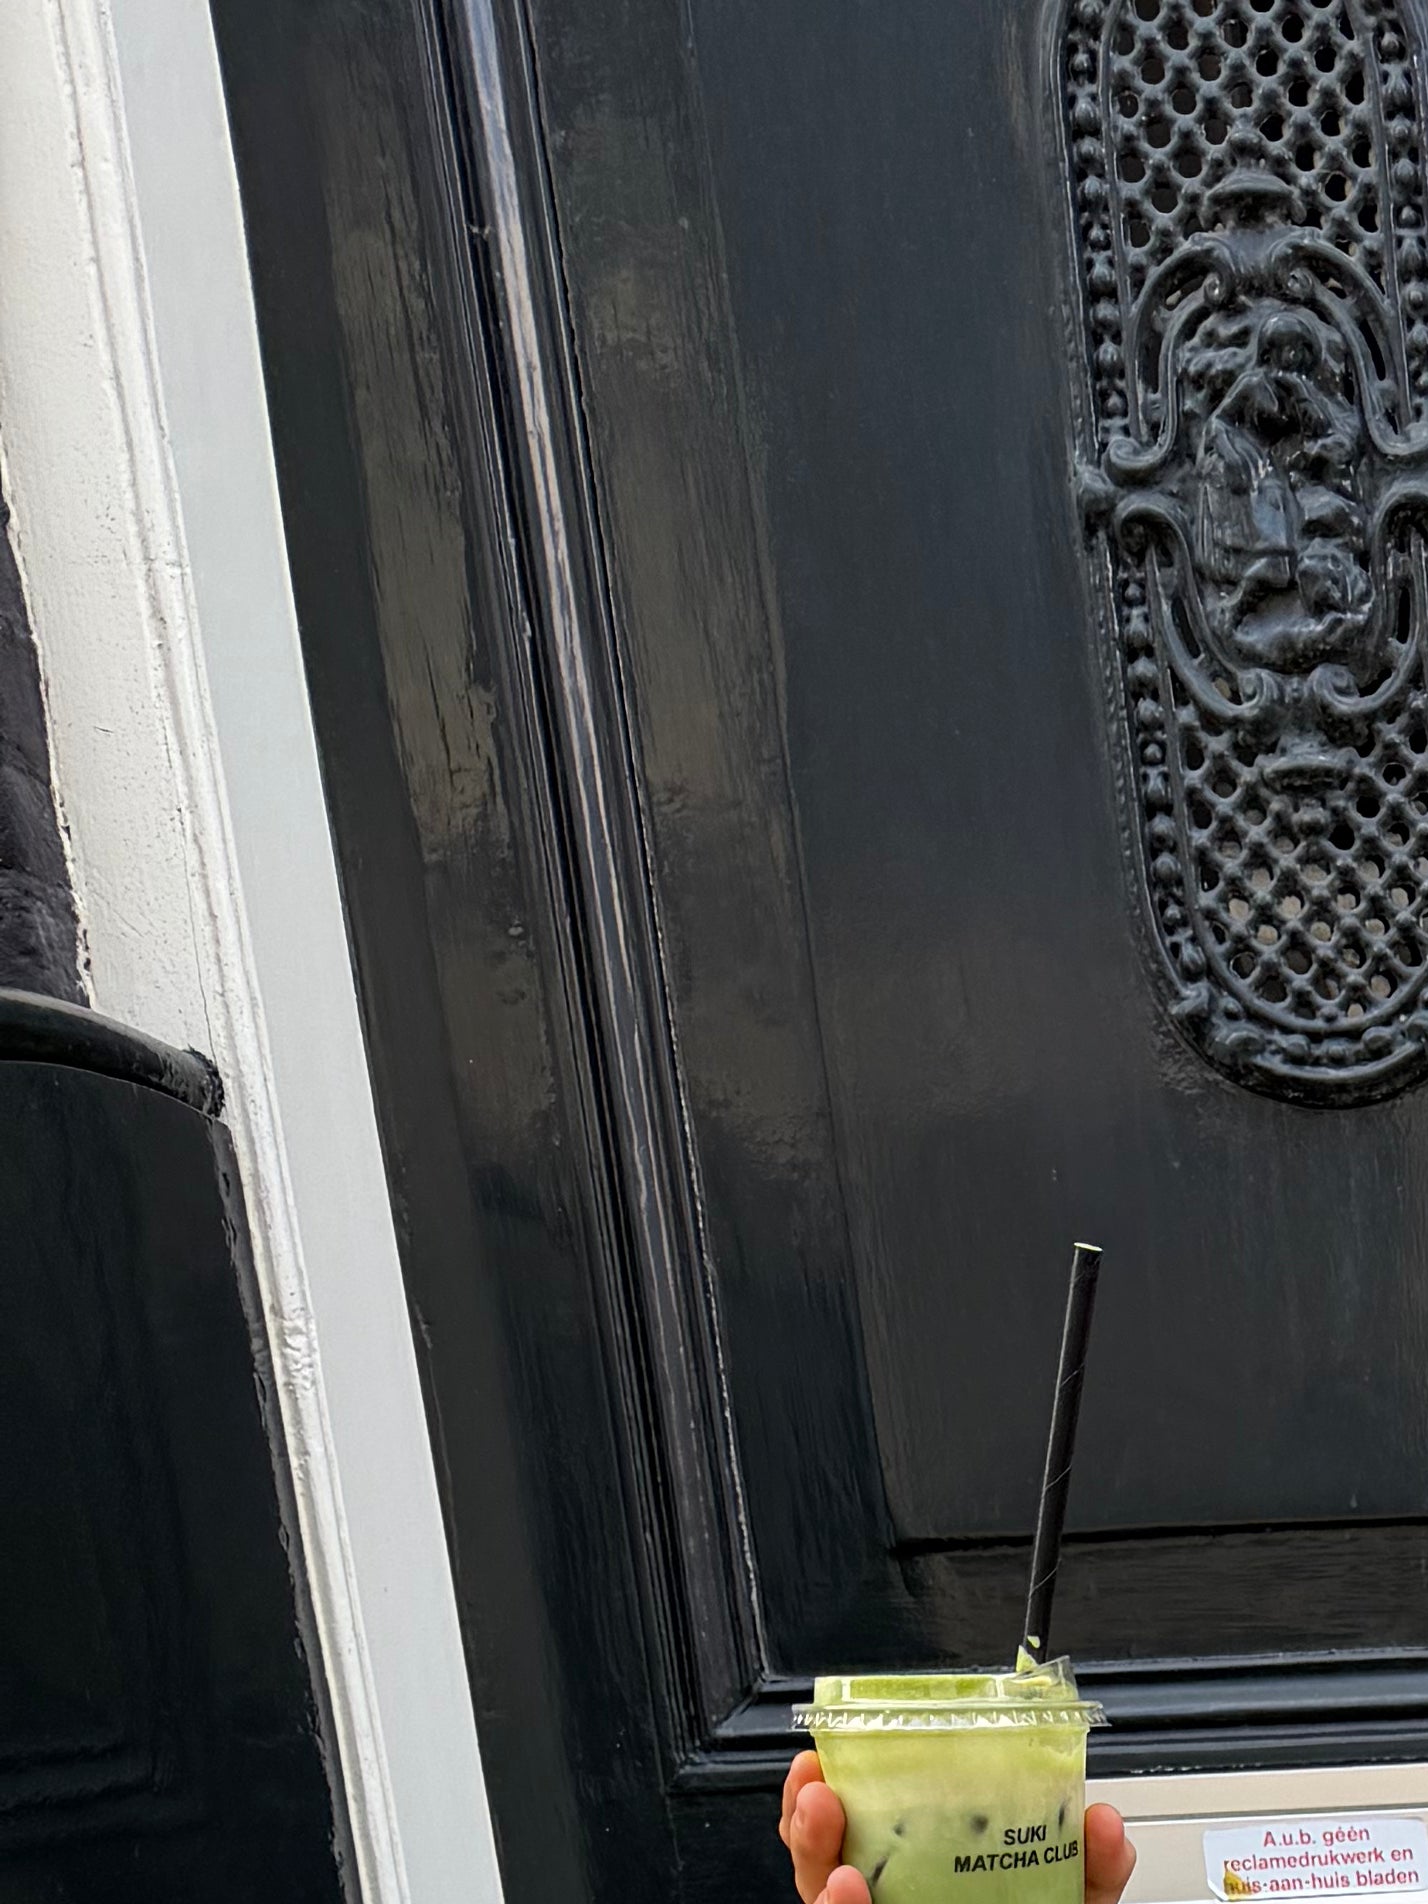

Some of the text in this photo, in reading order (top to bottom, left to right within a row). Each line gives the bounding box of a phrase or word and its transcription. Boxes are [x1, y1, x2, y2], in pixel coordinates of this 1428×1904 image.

[1003, 1824, 1047, 1846] SUKI
[1263, 1828, 1316, 1847] A.u.b.
[953, 1840, 1079, 1873] MATCHA CLUB
[1223, 1847, 1413, 1873] reclamedrukwerk en
[1356, 1867, 1419, 1887] bladen
